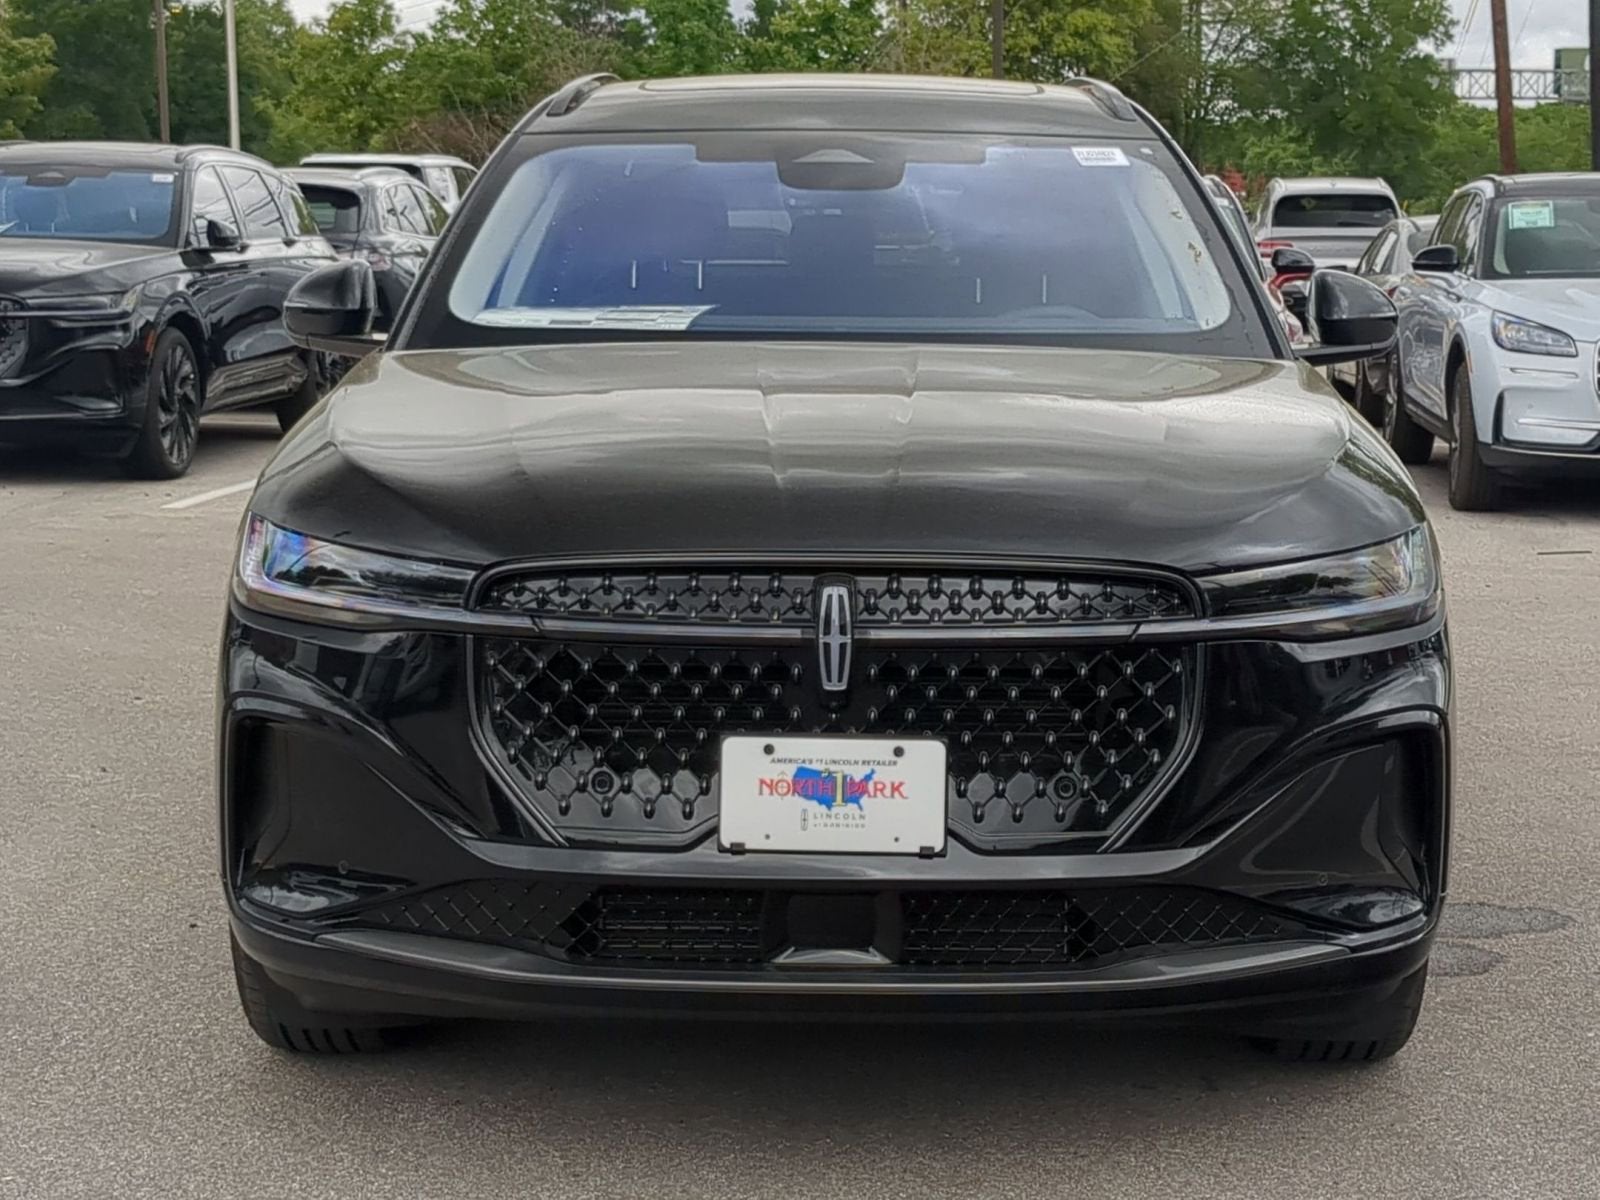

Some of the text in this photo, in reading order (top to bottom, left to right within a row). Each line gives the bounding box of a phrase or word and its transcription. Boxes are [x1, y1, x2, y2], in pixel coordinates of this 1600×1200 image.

[770, 757, 813, 765] AMERICA'S
[824, 758, 859, 767] LINCOLN
[861, 759, 898, 767] RETAILER
[757, 777, 834, 797] NORTH
[847, 779, 909, 799] PARK
[813, 812, 866, 820] LINCOLN
